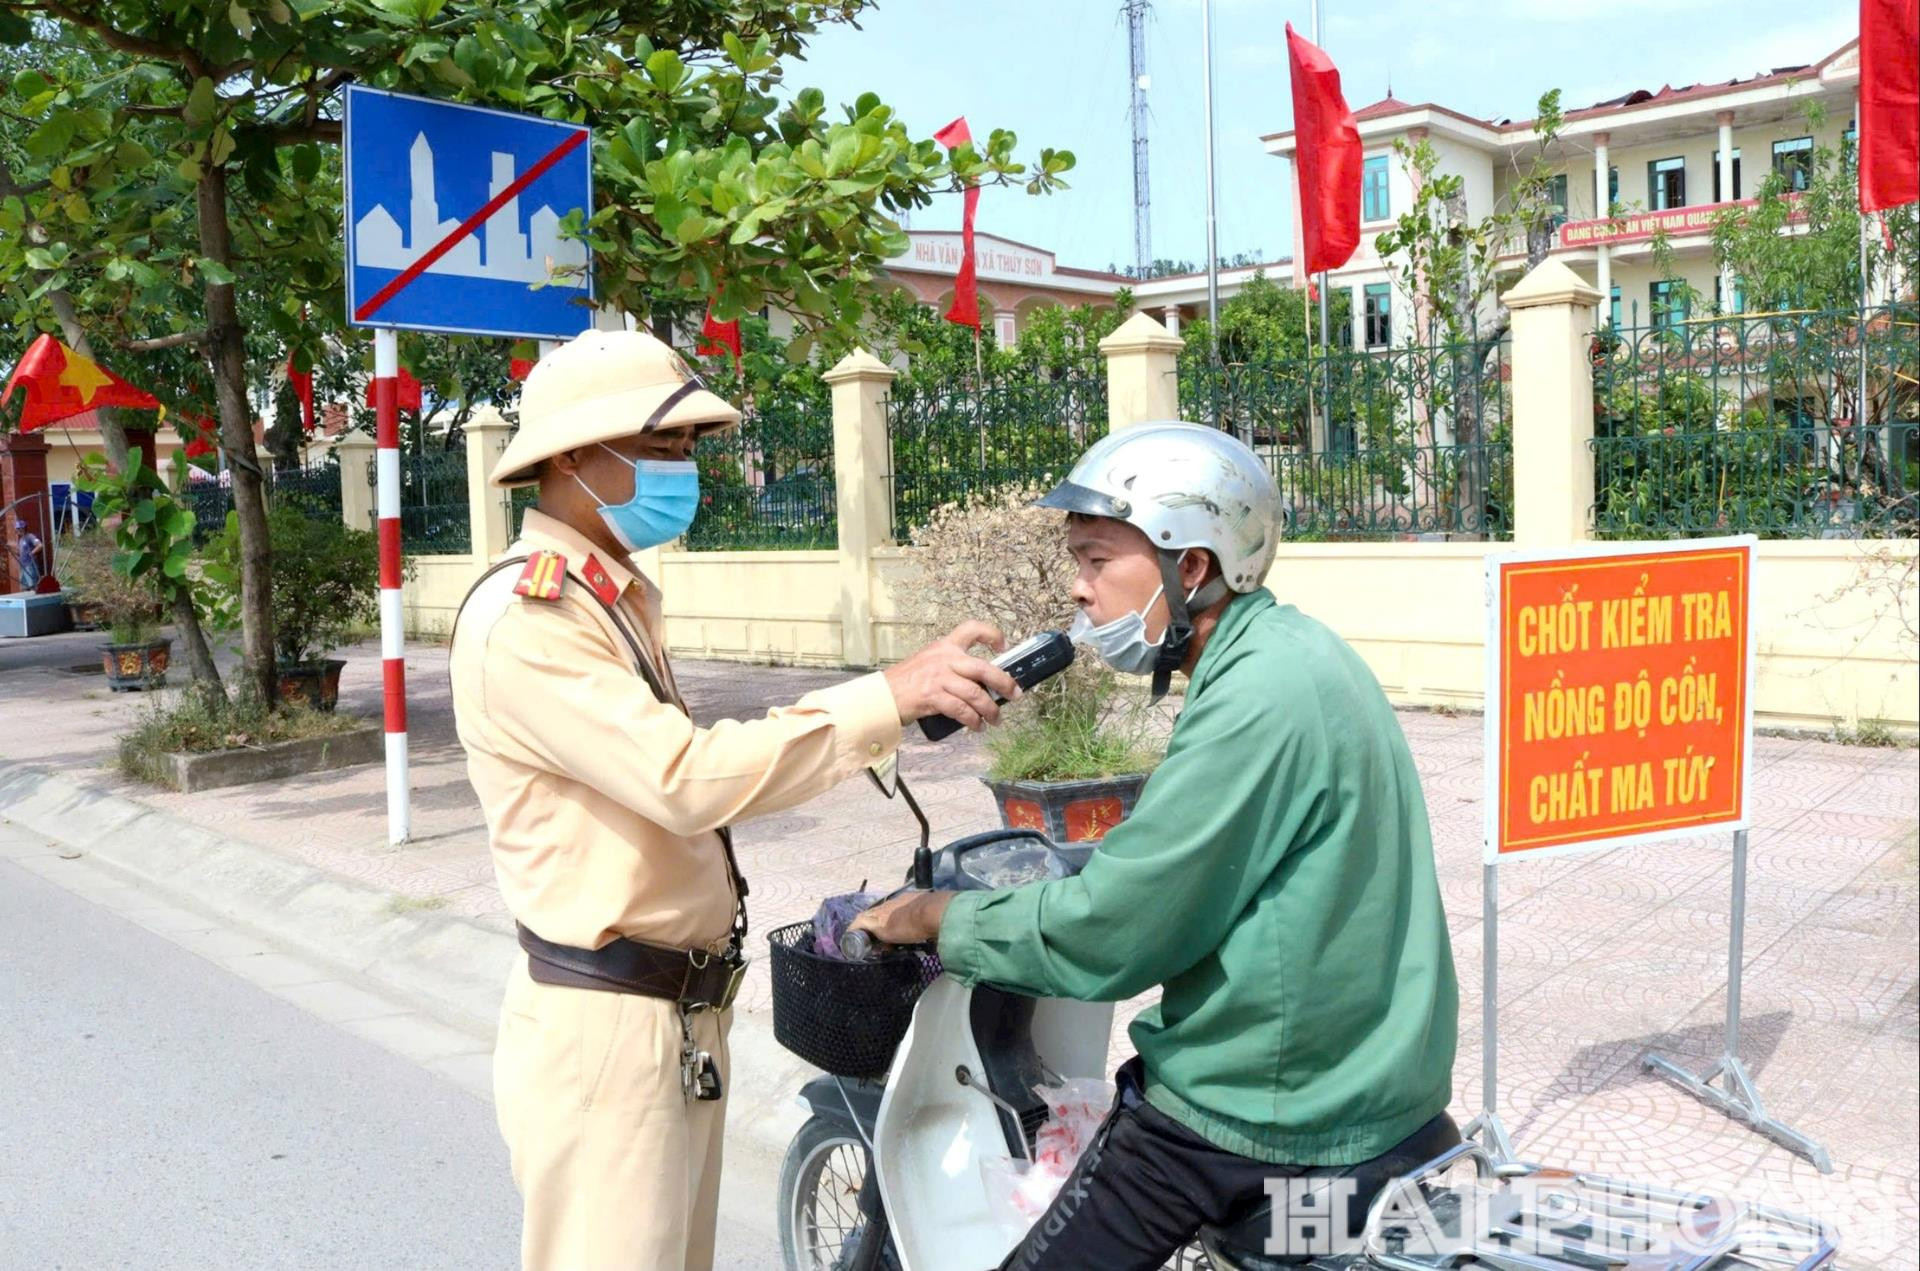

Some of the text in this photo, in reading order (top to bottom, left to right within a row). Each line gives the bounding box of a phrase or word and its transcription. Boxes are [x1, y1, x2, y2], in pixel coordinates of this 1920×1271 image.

[1662, 213, 1685, 229] NAM
[1518, 573, 1732, 657] CHỐT KIỂM TRA
[1523, 655, 1723, 742] NỒNG ĐỘ CỒN,
[1529, 751, 1604, 825] CHẤT
[1610, 762, 1655, 814] MA
